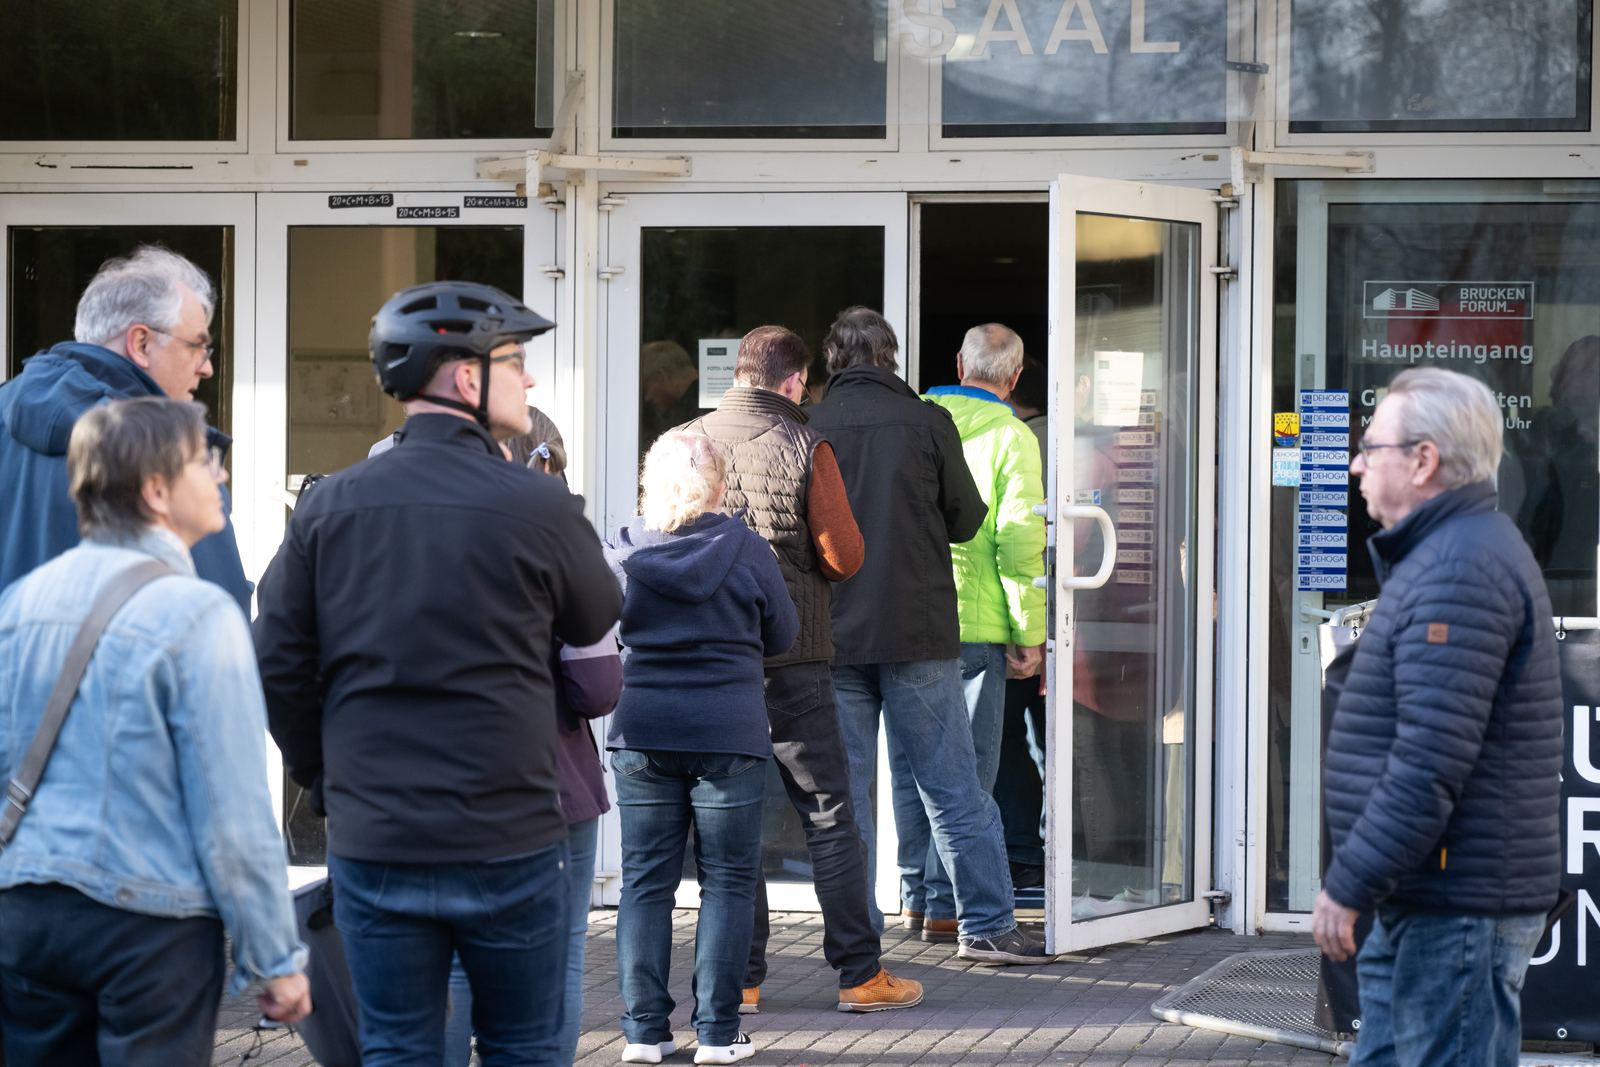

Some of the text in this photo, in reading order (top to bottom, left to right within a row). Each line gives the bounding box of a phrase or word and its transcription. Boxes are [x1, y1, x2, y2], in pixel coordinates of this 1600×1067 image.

[902, 0, 1181, 58] SAAL
[1460, 288, 1525, 299] BRÜCKEN
[1361, 339, 1534, 365] Haupteingang
[1313, 394, 1347, 402] DEHOGA
[1313, 414, 1347, 422] DEHOGA
[1506, 417, 1532, 429] Uhr
[1313, 434, 1347, 442] DEHOGA
[1313, 452, 1347, 460] DEHOGA
[1313, 472, 1346, 480] DEHOGA
[1311, 493, 1346, 501] DEHOGA
[1311, 514, 1345, 522] DEHOGA
[1311, 555, 1344, 563] DEHOGA
